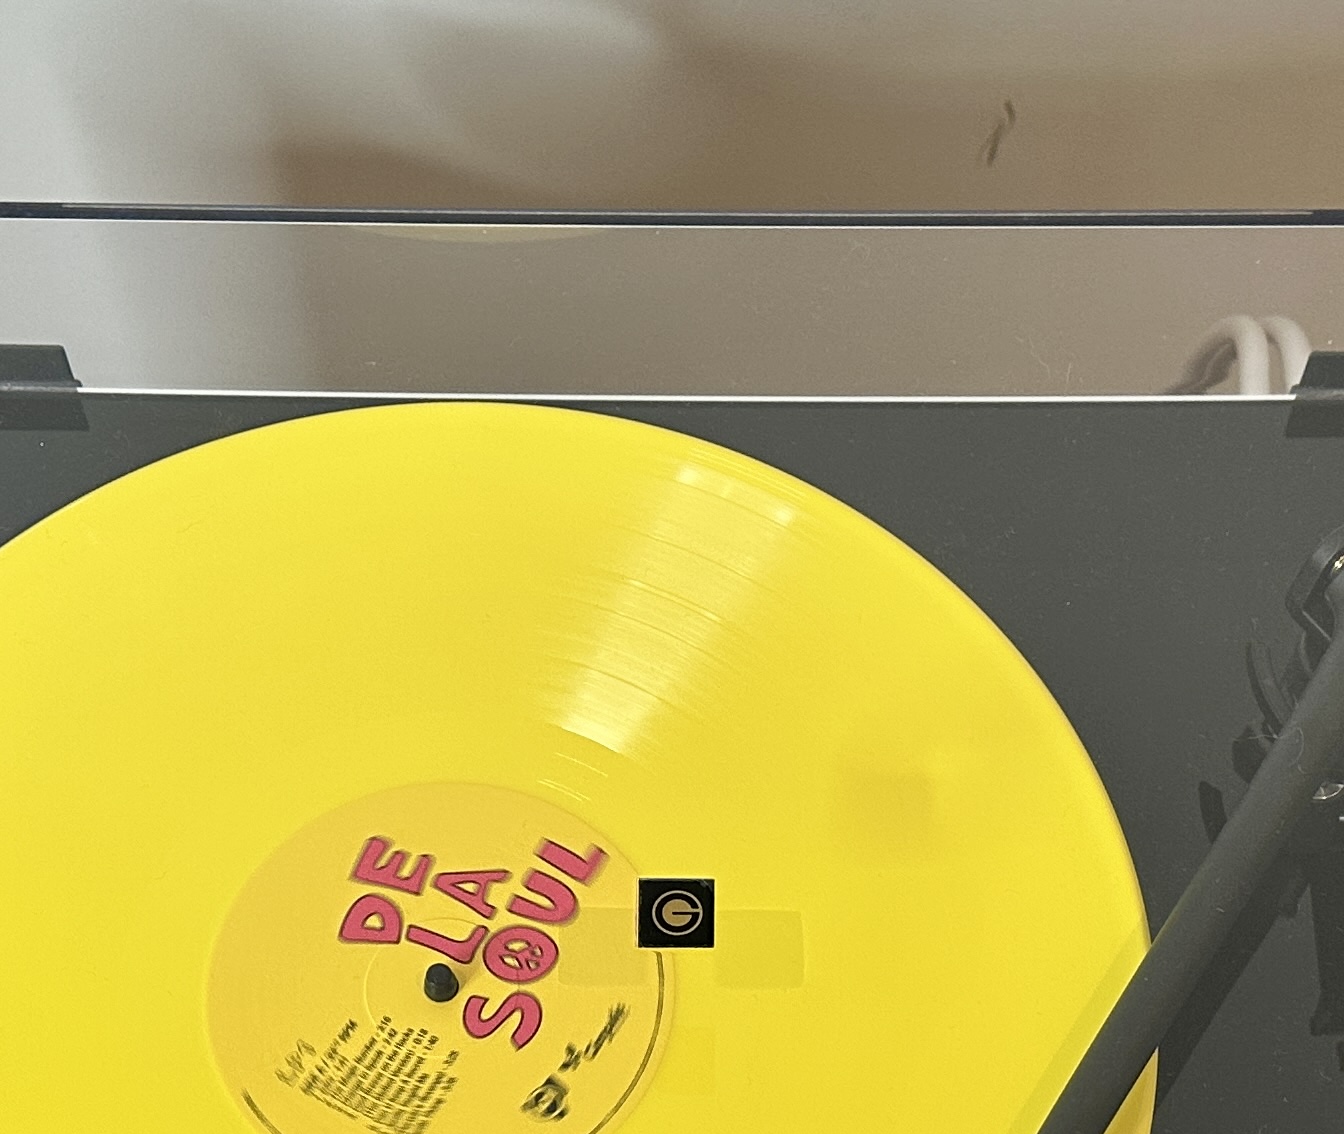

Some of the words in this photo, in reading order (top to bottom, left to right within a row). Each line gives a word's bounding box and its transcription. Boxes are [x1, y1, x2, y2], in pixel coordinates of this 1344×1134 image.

[338, 835, 436, 945] DE
[406, 867, 513, 964] LA
[462, 837, 610, 1053] SOUL
